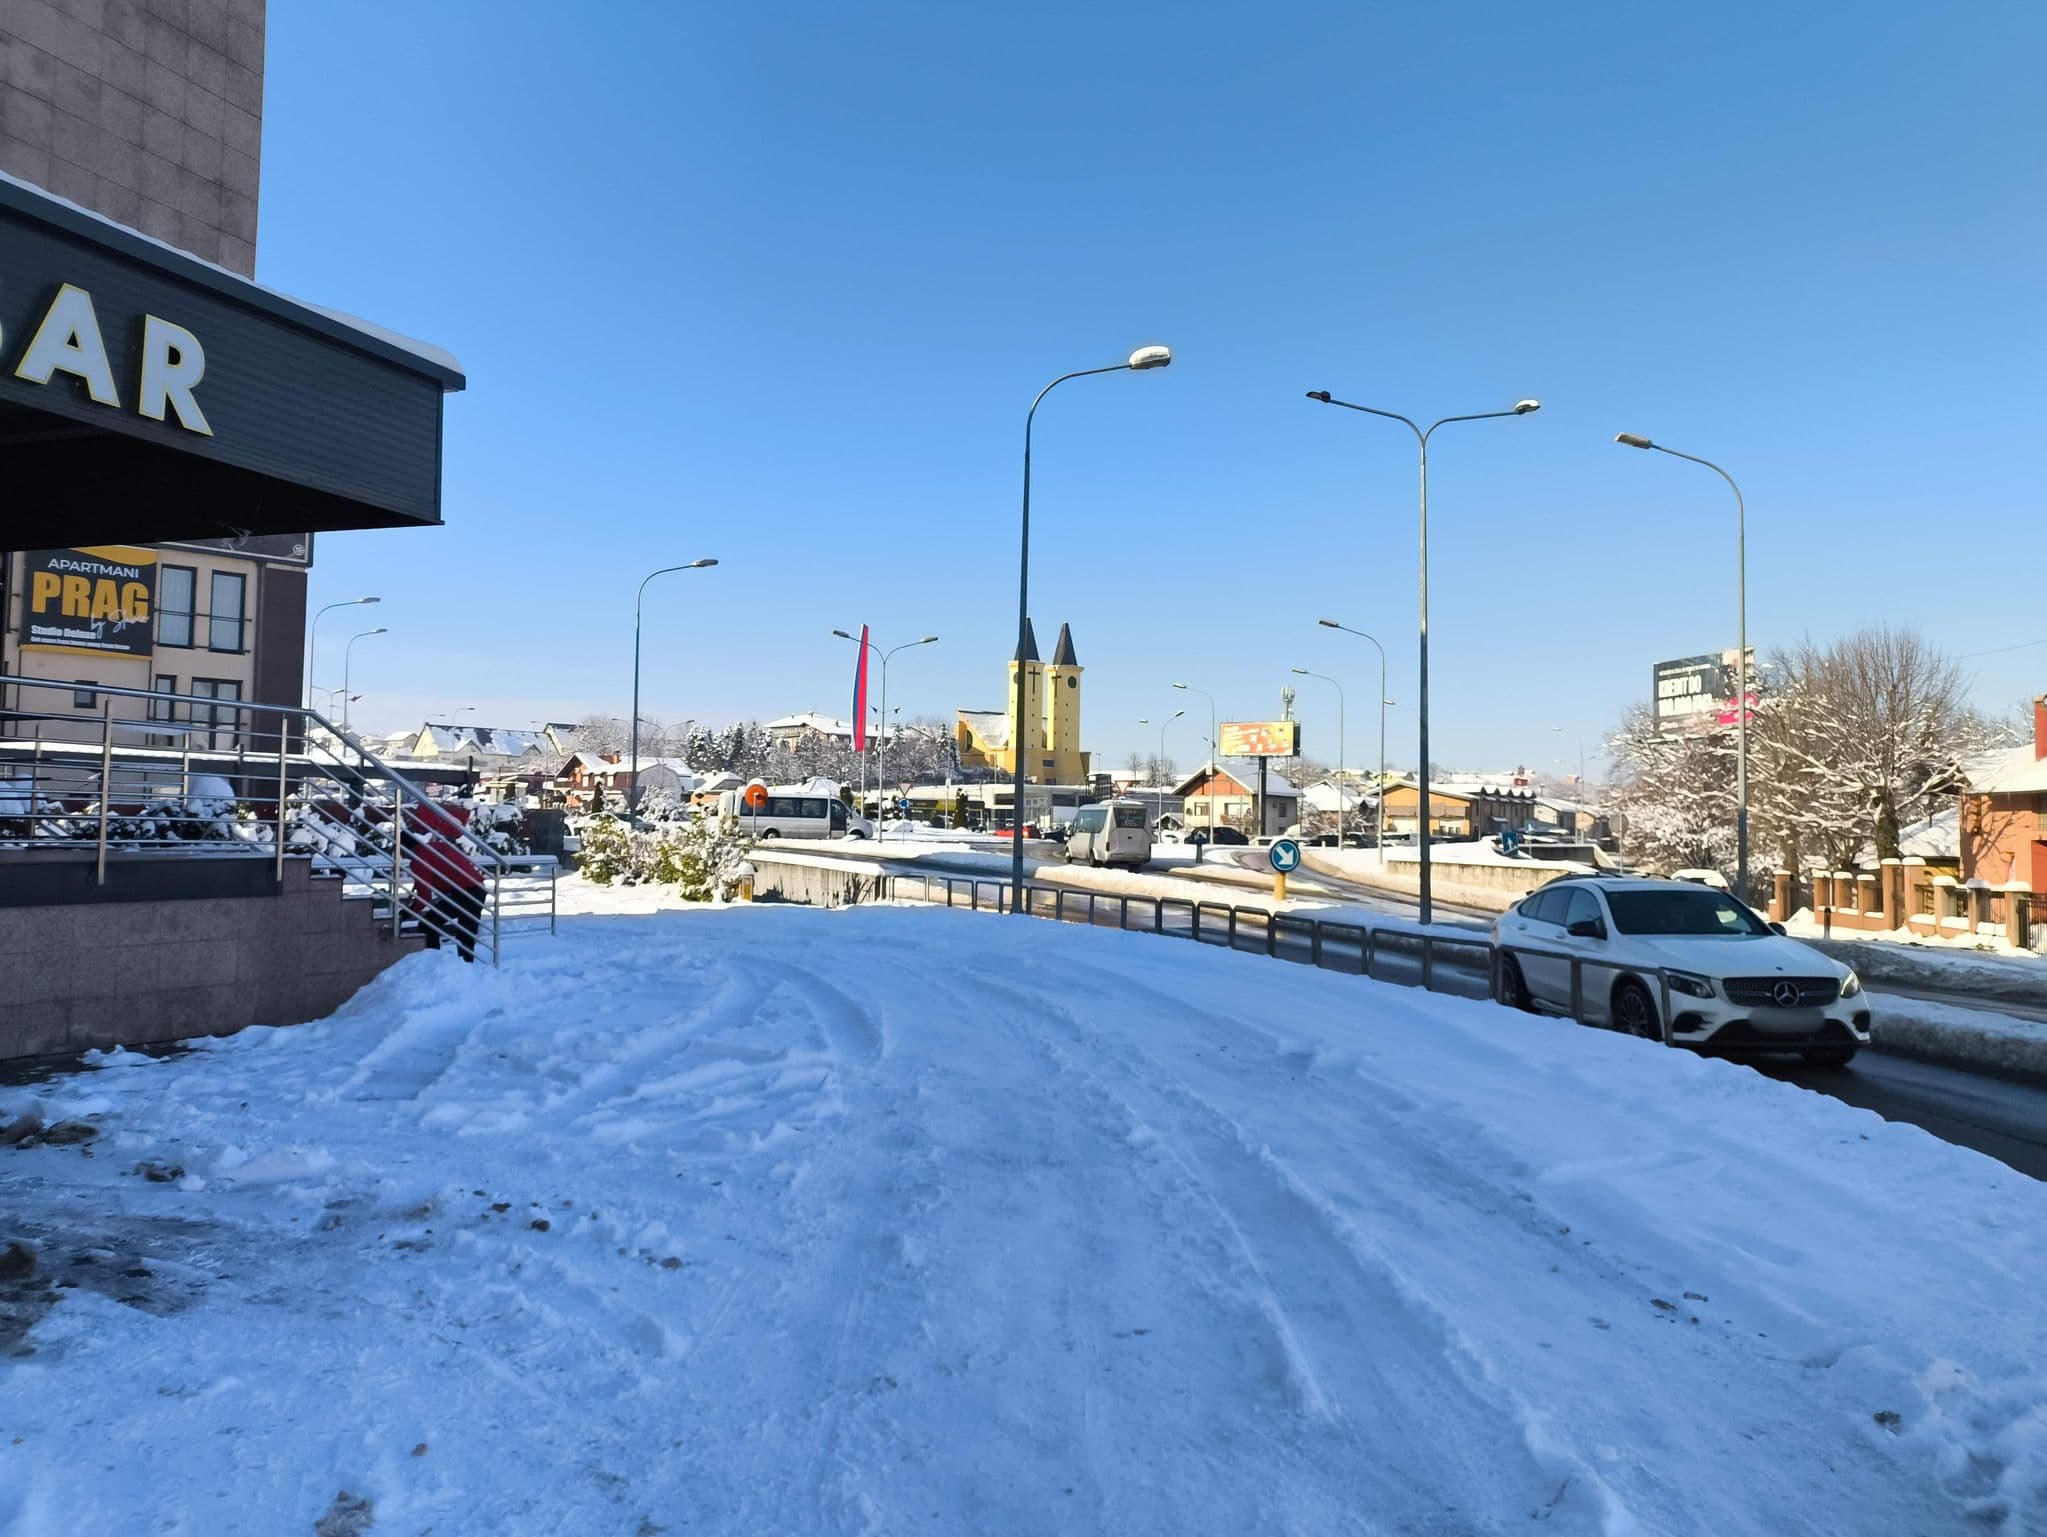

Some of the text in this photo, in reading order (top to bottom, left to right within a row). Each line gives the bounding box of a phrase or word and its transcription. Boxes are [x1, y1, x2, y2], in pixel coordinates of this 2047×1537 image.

[0, 282, 214, 437] AR
[47, 558, 139, 579] APARTMANI
[31, 570, 150, 624] PRAG
